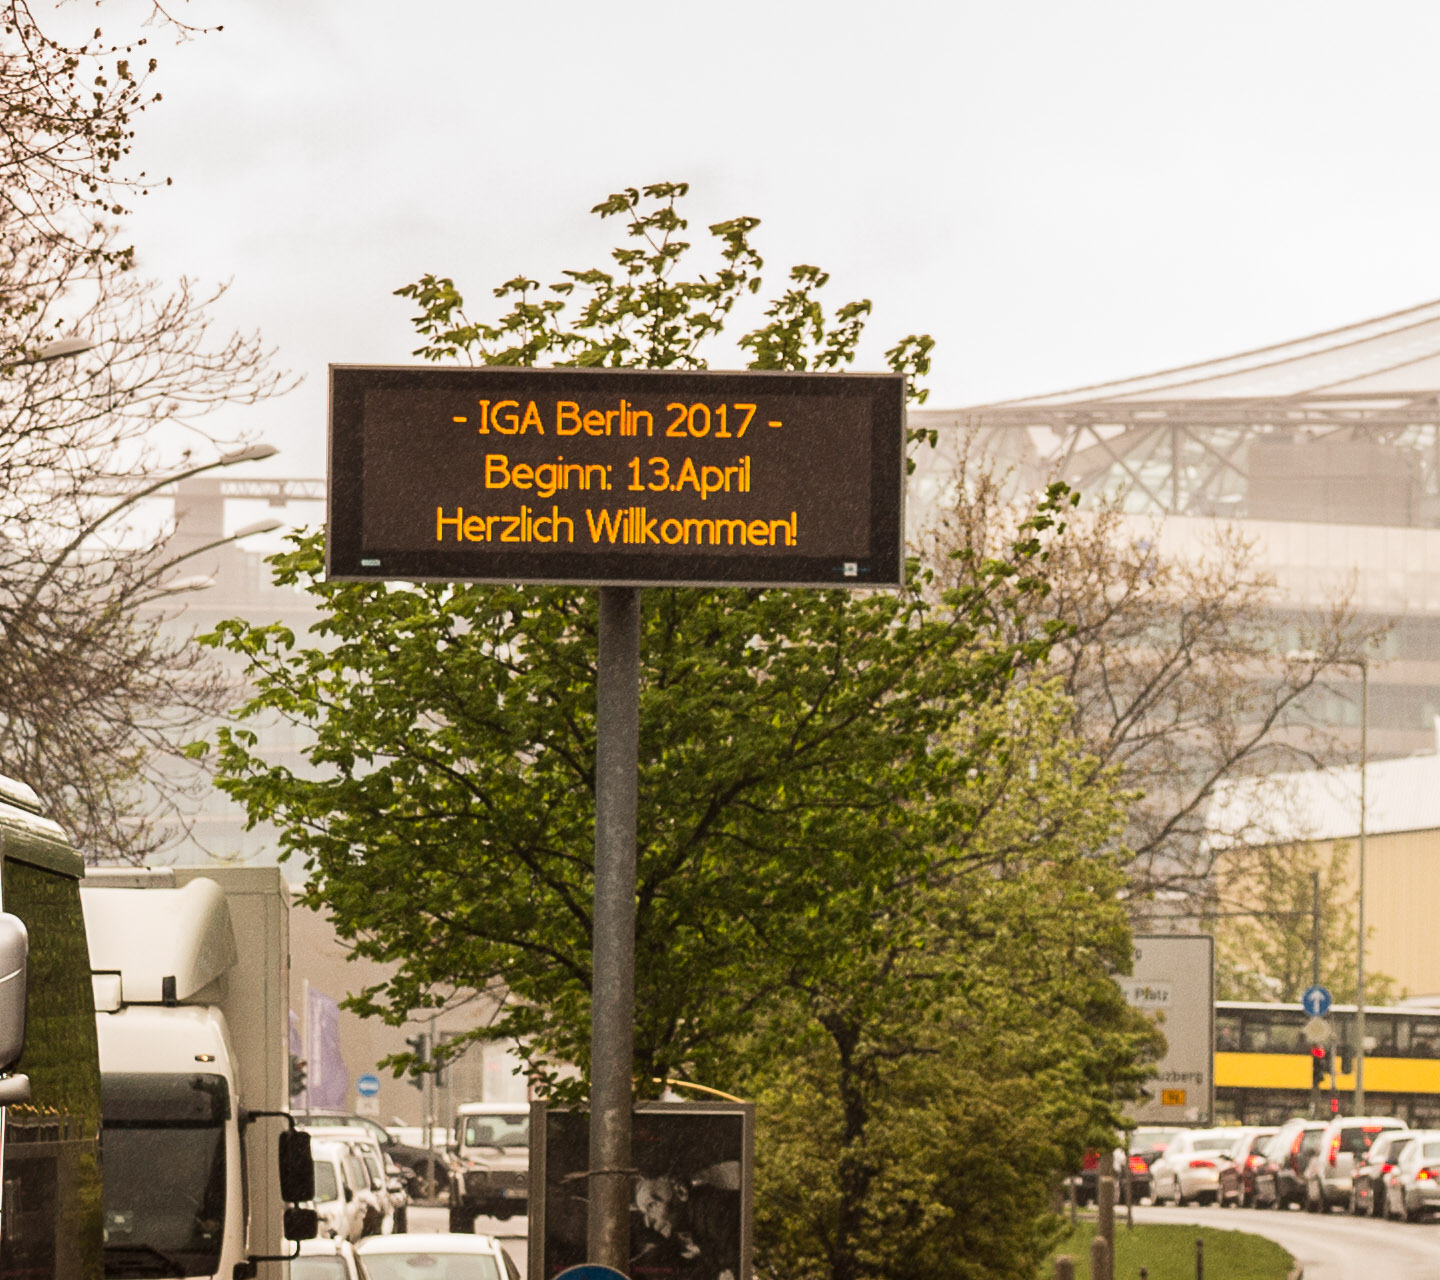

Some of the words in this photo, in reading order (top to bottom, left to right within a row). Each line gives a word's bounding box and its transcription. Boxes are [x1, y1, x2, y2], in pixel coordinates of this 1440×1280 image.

[478, 399, 545, 435] IGA
[557, 400, 653, 437] Berlin
[665, 403, 757, 439] 2017
[485, 454, 613, 497] Beginn:
[627, 457, 751, 500] 13.April
[436, 506, 574, 543] Herzlich
[587, 508, 798, 547] Willkommen!
